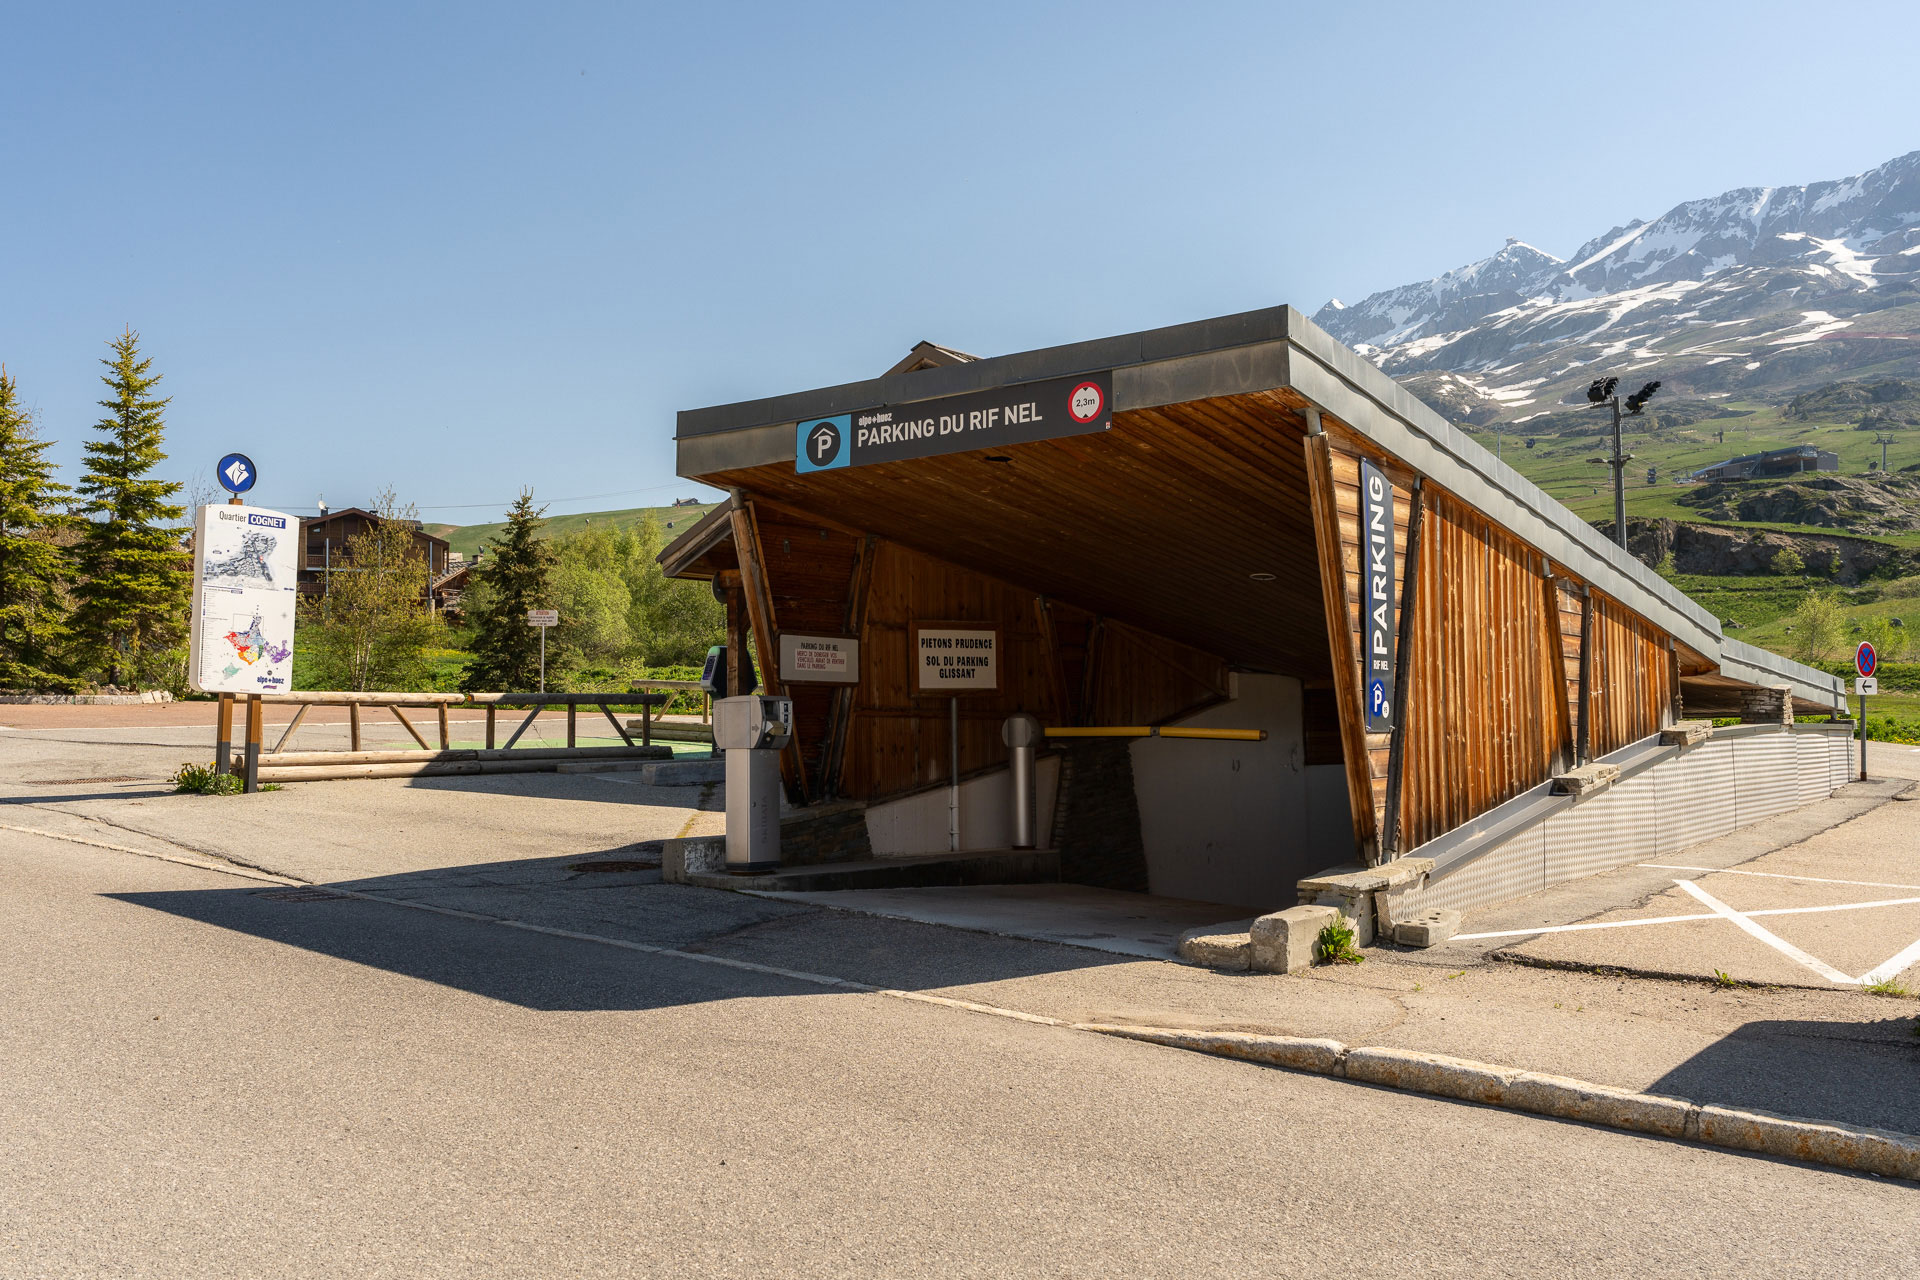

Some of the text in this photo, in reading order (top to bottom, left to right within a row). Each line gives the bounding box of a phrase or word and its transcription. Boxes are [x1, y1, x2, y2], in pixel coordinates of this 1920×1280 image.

[1076, 397, 1096, 408] 2,3m
[858, 402, 1043, 448] PARKING DU RIF NEL
[219, 510, 284, 528] Quartier COGNET
[1369, 475, 1388, 655] PARKING
[800, 642, 818, 650] PARKING
[920, 638, 993, 650] PIETONS PRUDENCE
[926, 655, 989, 667] SOL DU PARKING
[1381, 660, 1389, 670] NEL
[939, 668, 976, 679] GLISSANT
